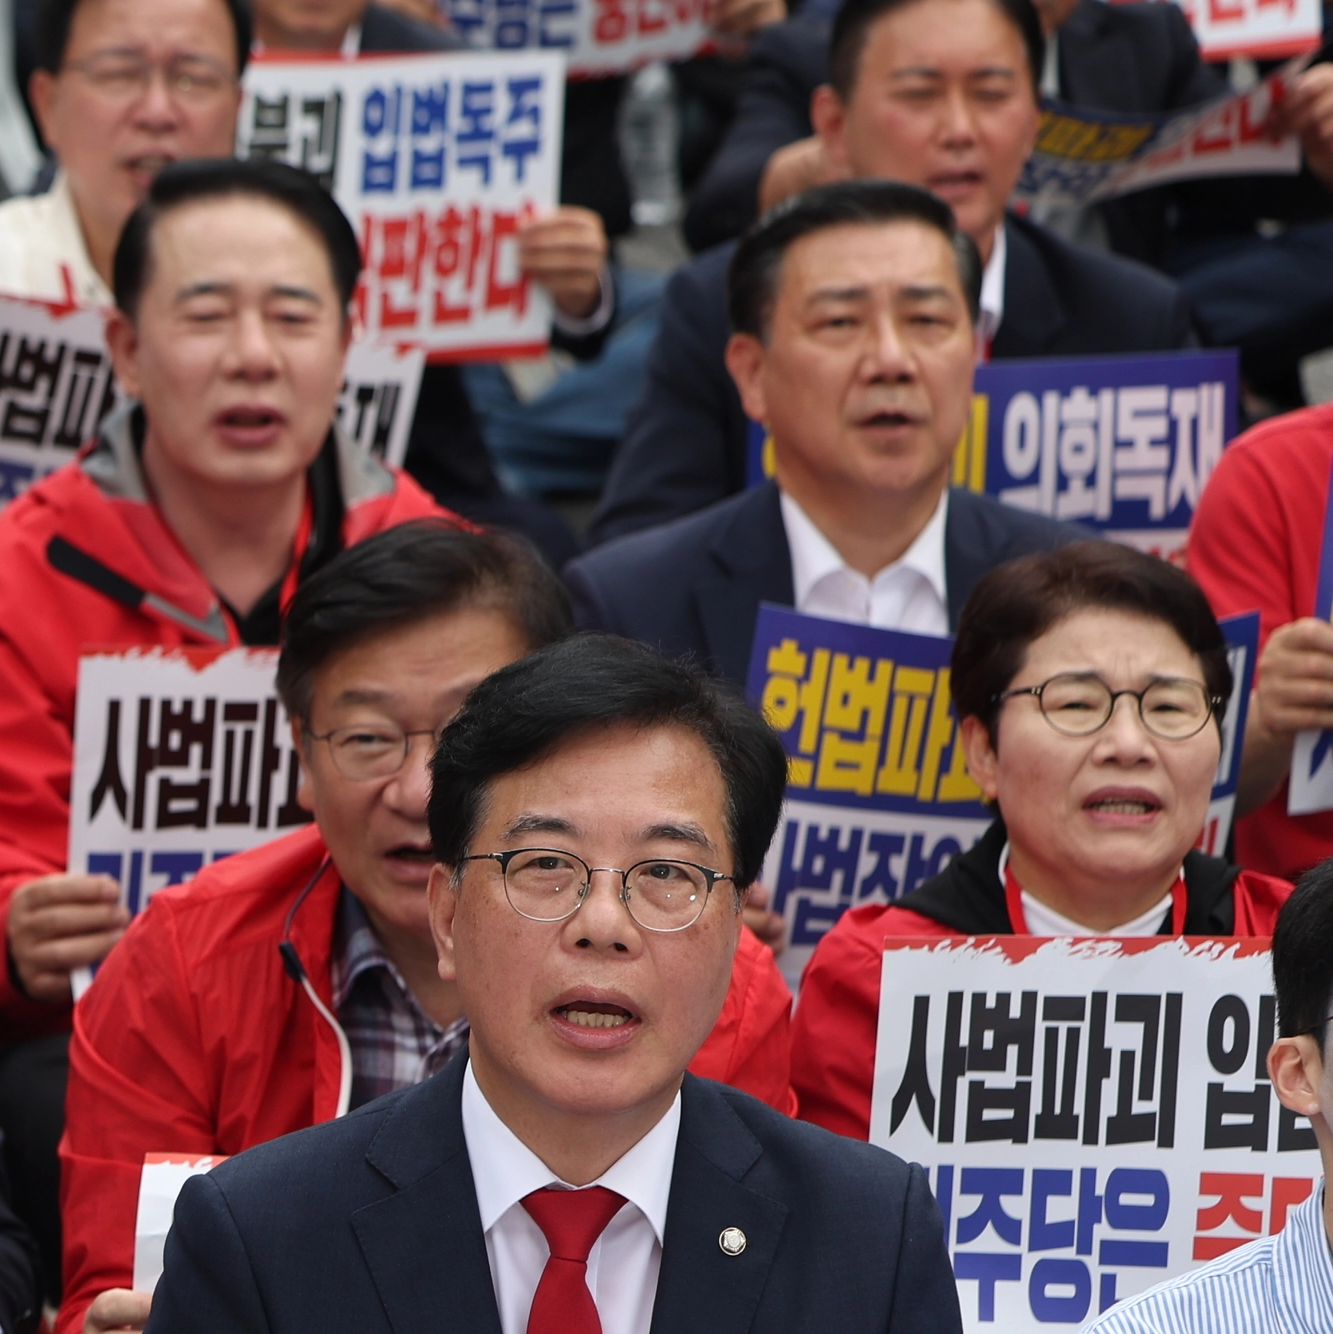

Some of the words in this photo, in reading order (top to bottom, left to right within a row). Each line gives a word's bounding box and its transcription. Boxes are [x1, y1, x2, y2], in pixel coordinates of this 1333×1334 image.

[360, 73, 543, 195] 입법독주
[999, 382, 1225, 522] 의회독재
[889, 990, 1184, 1149] 사법파괴
